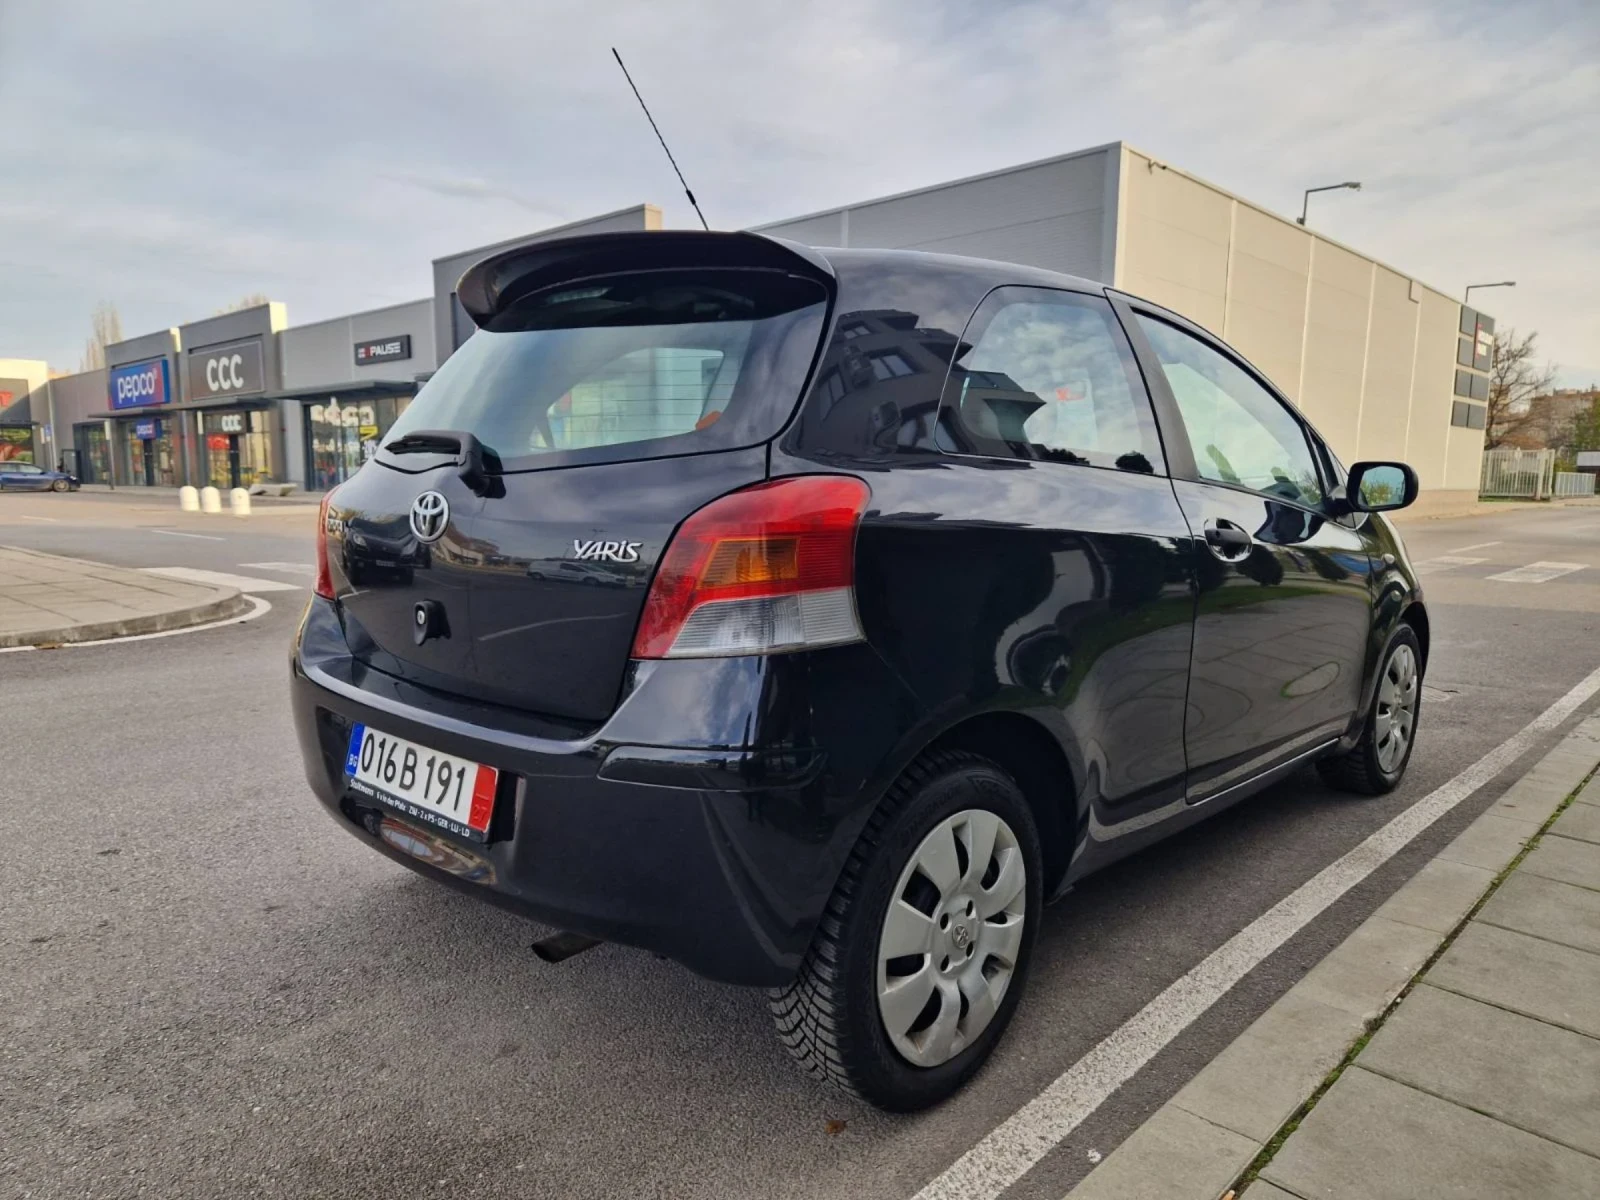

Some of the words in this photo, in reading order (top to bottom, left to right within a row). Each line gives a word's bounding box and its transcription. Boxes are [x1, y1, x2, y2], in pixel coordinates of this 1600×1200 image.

[369, 341, 401, 357] PAUSE
[206, 354, 244, 392] CCC
[117, 370, 156, 405] pepco
[221, 414, 242, 432] CCC
[573, 539, 643, 563] YARIS
[348, 754, 358, 767] BG
